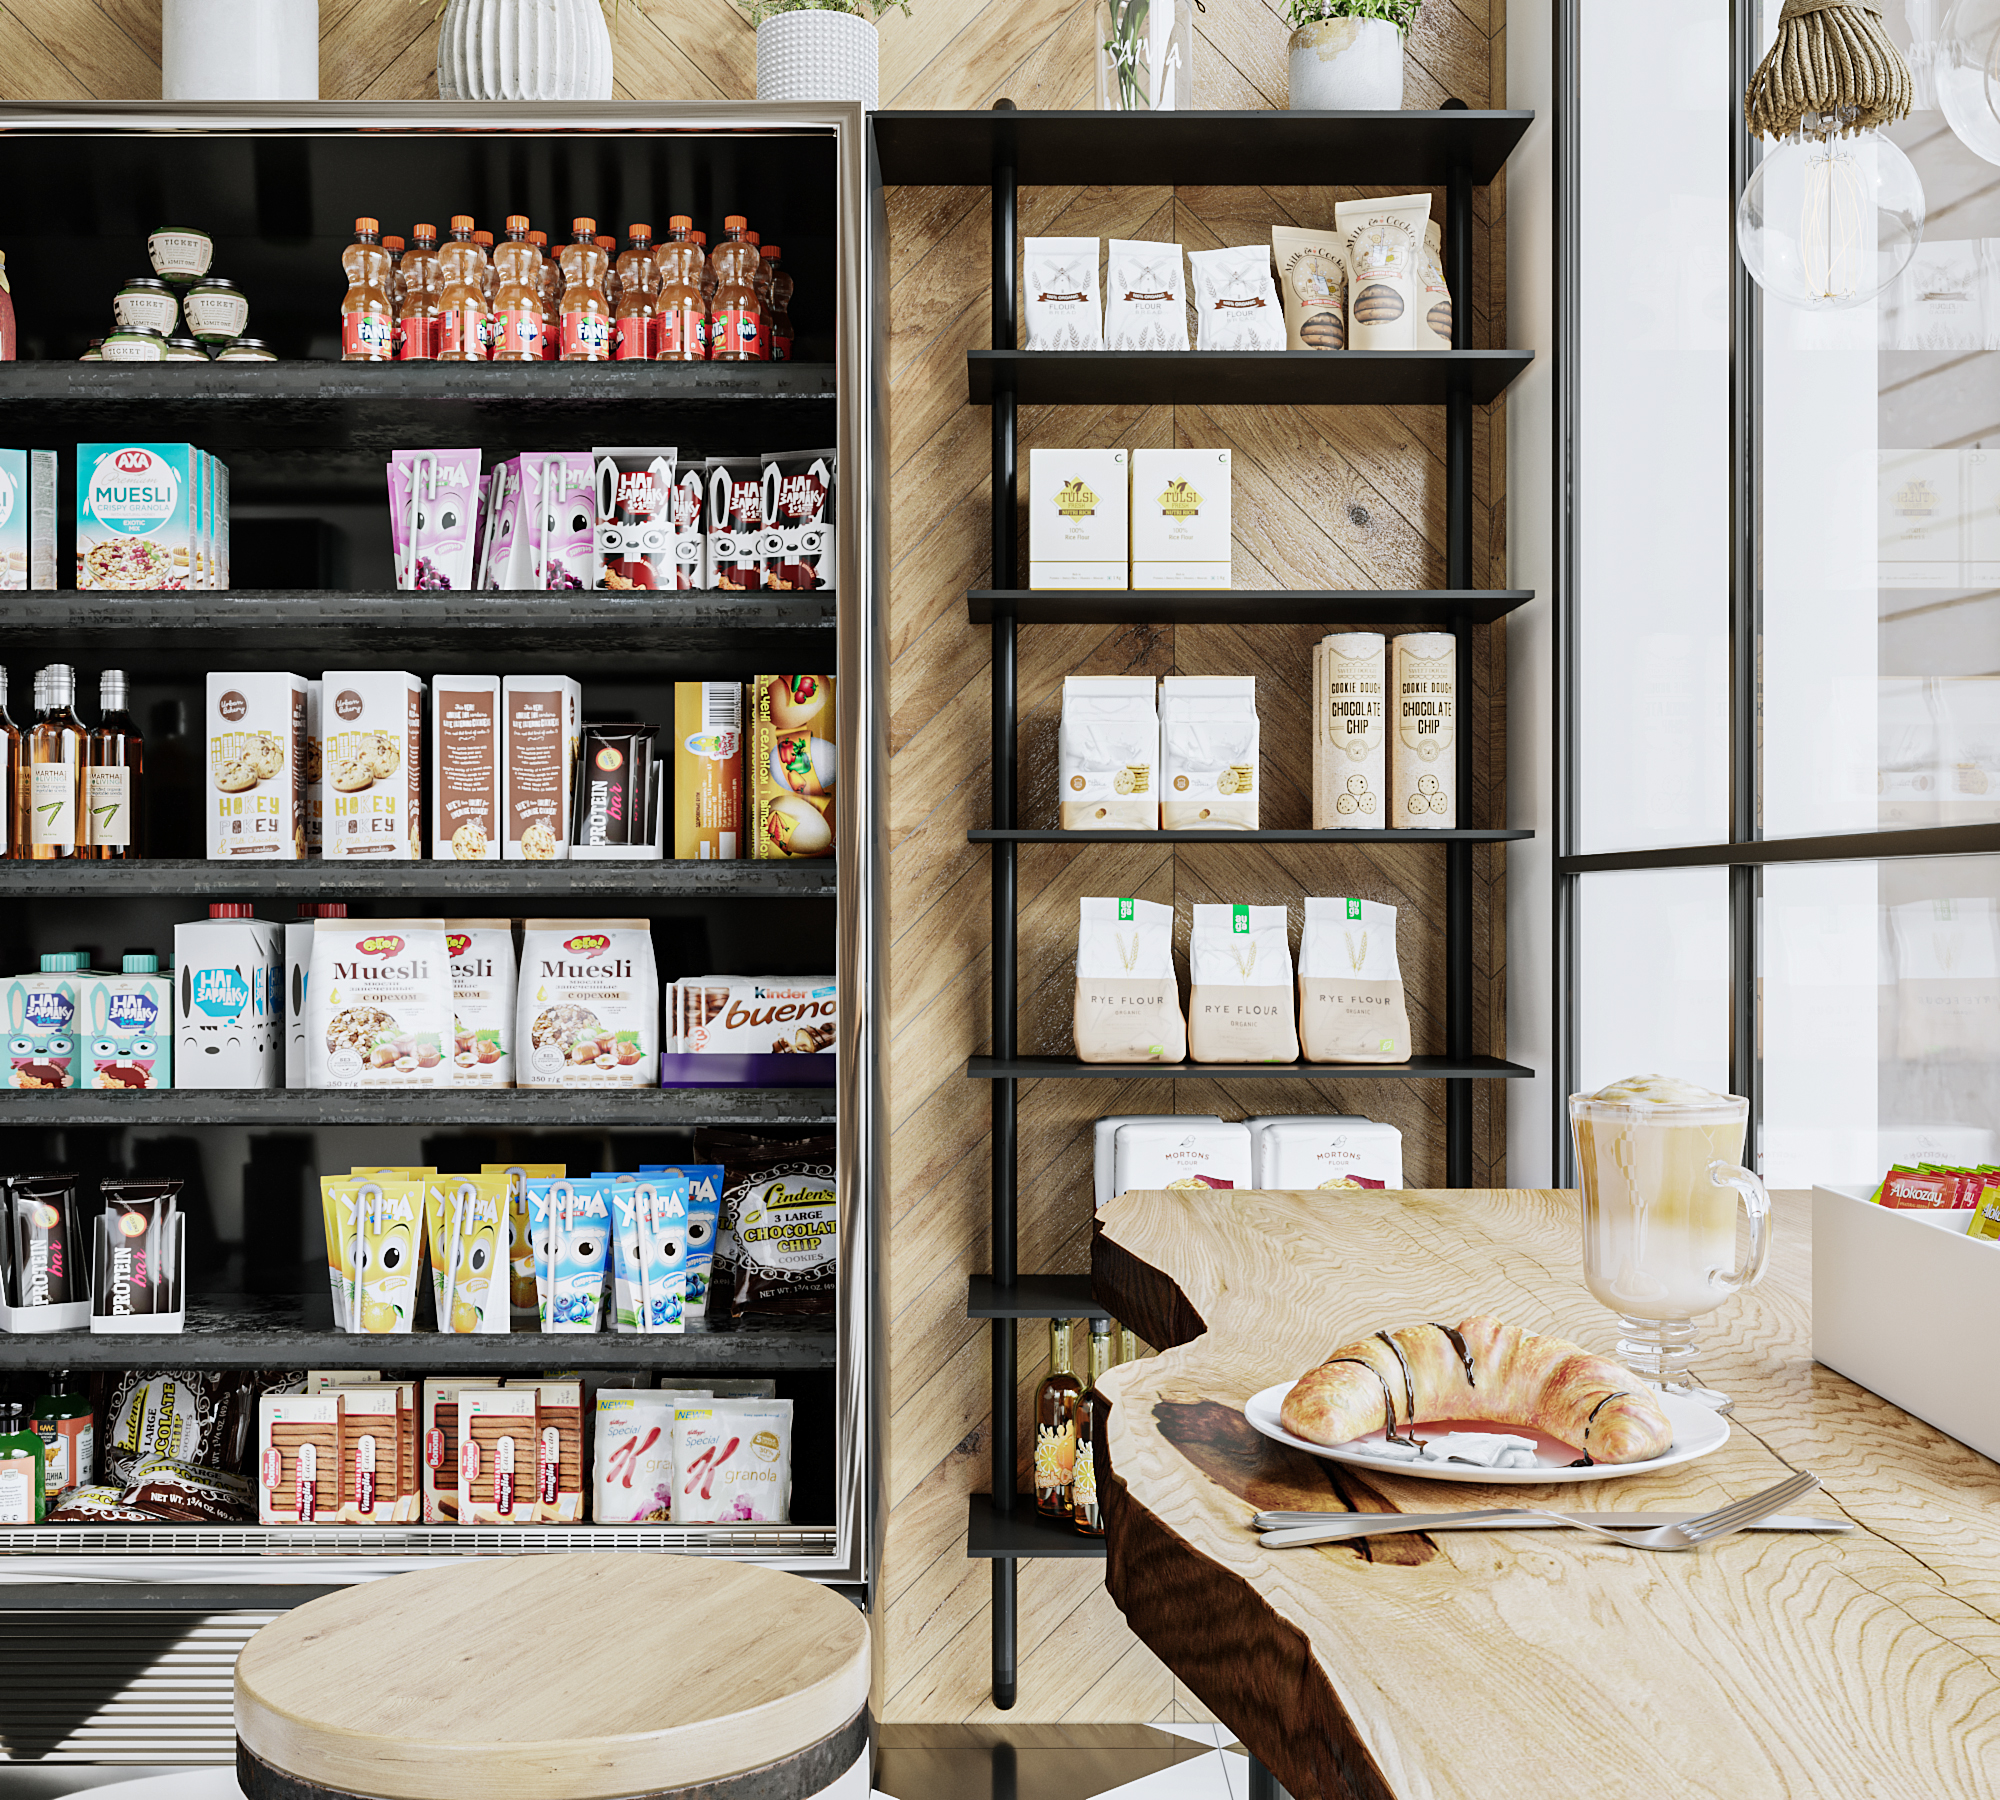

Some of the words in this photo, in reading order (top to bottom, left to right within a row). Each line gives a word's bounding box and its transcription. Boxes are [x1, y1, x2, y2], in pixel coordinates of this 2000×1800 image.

[1346, 225, 1366, 249] Milk
[1386, 215, 1417, 248] Cookies
[164, 239, 199, 248] TICKET
[130, 300, 164, 308] TICKET
[200, 300, 235, 308] TICKET
[1226, 310, 1254, 318] FLOUR
[516, 322, 538, 336] FANTA
[736, 322, 758, 336] FANTA
[108, 348, 141, 356] TICKET
[118, 452, 150, 468] AXA
[101, 472, 158, 486] Premium
[621, 472, 652, 490] НА!
[783, 476, 812, 493] НА!
[96, 486, 170, 502] MUESLI
[1060, 492, 1093, 502] TULSI
[1164, 492, 1196, 502] TULSI
[97, 504, 128, 512] CRISPY
[130, 504, 170, 512] GRANOLA
[1332, 682, 1356, 694] COOKIE
[1360, 682, 1380, 694] DOUGH
[1402, 682, 1428, 694] COOKIE
[1431, 682, 1452, 694] DOUGH
[221, 700, 244, 708] Urban
[336, 698, 360, 706] Urban
[338, 705, 362, 714] Bakery
[1332, 702, 1380, 716] CHOCOLATE
[1403, 702, 1452, 716] CHOCOLATE
[222, 706, 246, 715] Bakery
[1346, 720, 1368, 734] CHIP
[1418, 720, 1440, 734] CHIP
[219, 796, 280, 817] HOKEY
[336, 796, 396, 816] HOKEY
[604, 782, 622, 820] bar
[590, 780, 608, 846] PROTEIN
[219, 818, 280, 836] POKEY
[336, 818, 395, 836] POKEY
[332, 960, 430, 980] Muesli
[540, 960, 634, 978] Muesli
[201, 970, 232, 990] НА!
[372, 994, 417, 1002] орехом
[576, 992, 620, 1000] орехом
[755, 986, 808, 999] kinder
[1092, 996, 1114, 1004] RYE
[1122, 996, 1164, 1004] FLOUR
[1320, 994, 1344, 1004] RYE
[1352, 996, 1391, 1006] FLOUR
[30, 994, 59, 1009] НА!
[114, 995, 142, 1010] НА!
[726, 1000, 836, 1030] bueno
[1206, 1005, 1230, 1014] RYE
[1238, 1006, 1278, 1016] FLOUR
[694, 1030, 708, 1041] 3
[1165, 1151, 1210, 1160] MORTONS
[1316, 1151, 1361, 1160] MORTONS
[763, 1182, 836, 1211] Linden's
[1890, 1181, 1945, 1207] Alokozay
[786, 1211, 823, 1222] LARGE
[744, 1220, 836, 1242] CHOCOLAT
[777, 1238, 822, 1252] CHIP
[46, 1240, 64, 1278] bar
[778, 1254, 824, 1264] COOKIES
[30, 1240, 49, 1306] PROTEIN
[130, 1248, 147, 1288] bar
[112, 1247, 132, 1316] PROTEIN
[760, 1290, 776, 1298] NET
[600, 1401, 627, 1410] NEW!
[677, 1411, 706, 1419] NEW!
[145, 1408, 157, 1446] LARGE
[608, 1426, 641, 1438] Special
[169, 1413, 183, 1458] CHIP
[182, 1414, 193, 1460] COOKIES
[685, 1436, 720, 1448] Special
[362, 1440, 370, 1470] Cacao
[430, 1431, 439, 1466] Bonomi
[302, 1449, 310, 1479] Cacao
[465, 1443, 474, 1478] Bonomi
[606, 1426, 662, 1488] K
[184, 1465, 222, 1480] LARGE
[266, 1450, 276, 1486] Bonomi
[684, 1436, 740, 1500] K
[546, 1464, 556, 1502] Vaniglia
[725, 1468, 777, 1484] granola
[361, 1472, 372, 1512] Vaniglia
[500, 1474, 511, 1513] Vaniglia
[150, 1492, 168, 1503] NET
[169, 1493, 185, 1506] WT.
[204, 1504, 216, 1514] OZ.
[302, 1481, 313, 1522] Vaniglia
